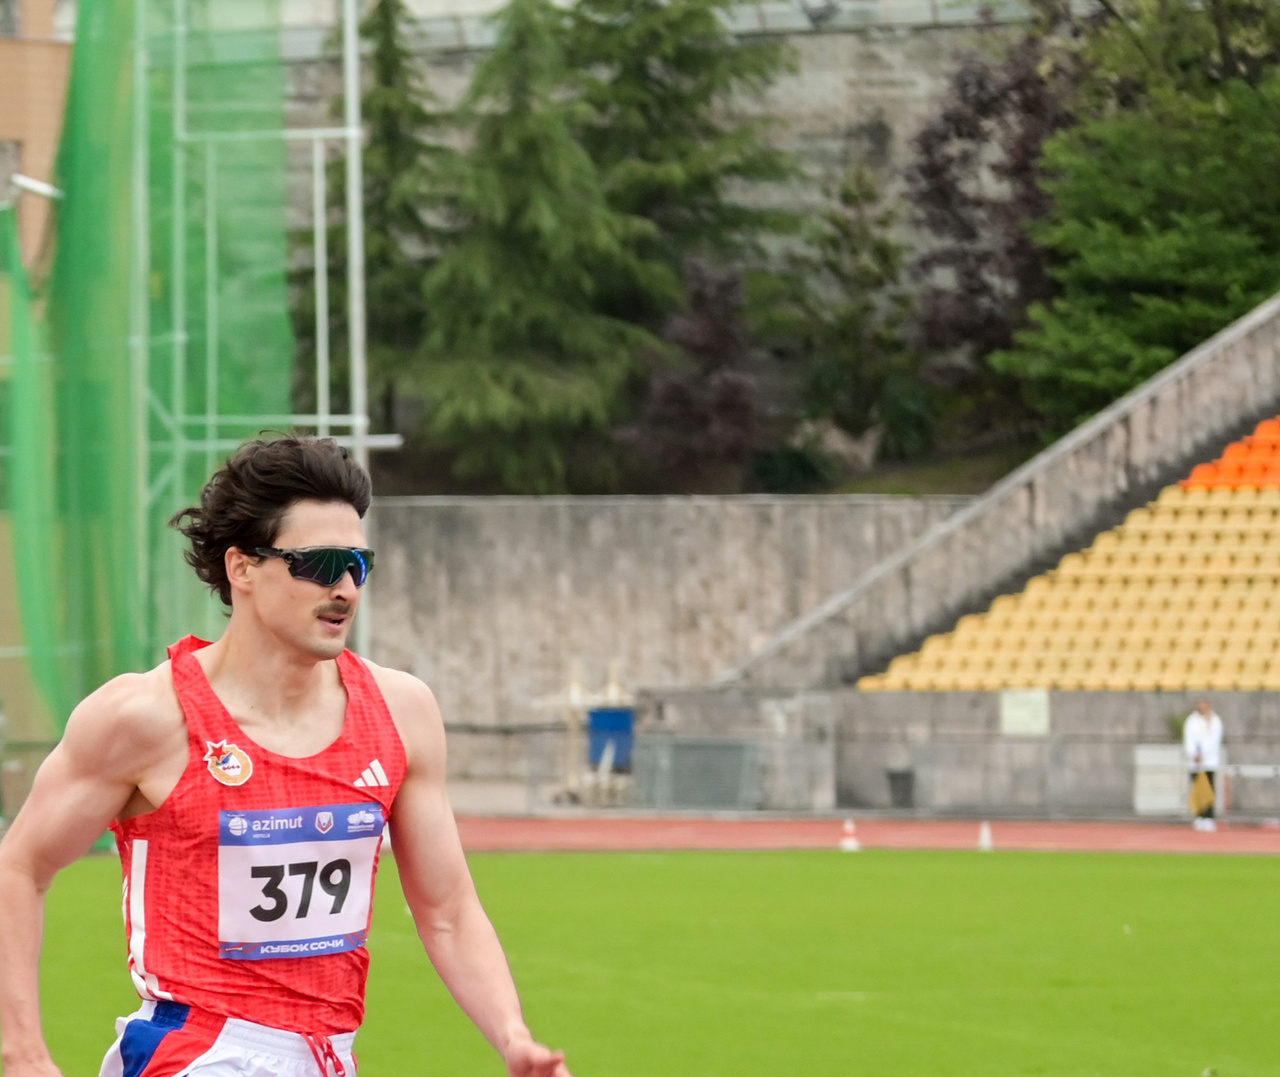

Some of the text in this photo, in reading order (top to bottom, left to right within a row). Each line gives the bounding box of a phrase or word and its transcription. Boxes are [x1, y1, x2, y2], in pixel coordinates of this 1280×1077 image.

[252, 816, 303, 831] azimut
[249, 858, 351, 922] 379
[260, 939, 344, 954] КУБОК СОЧИ
